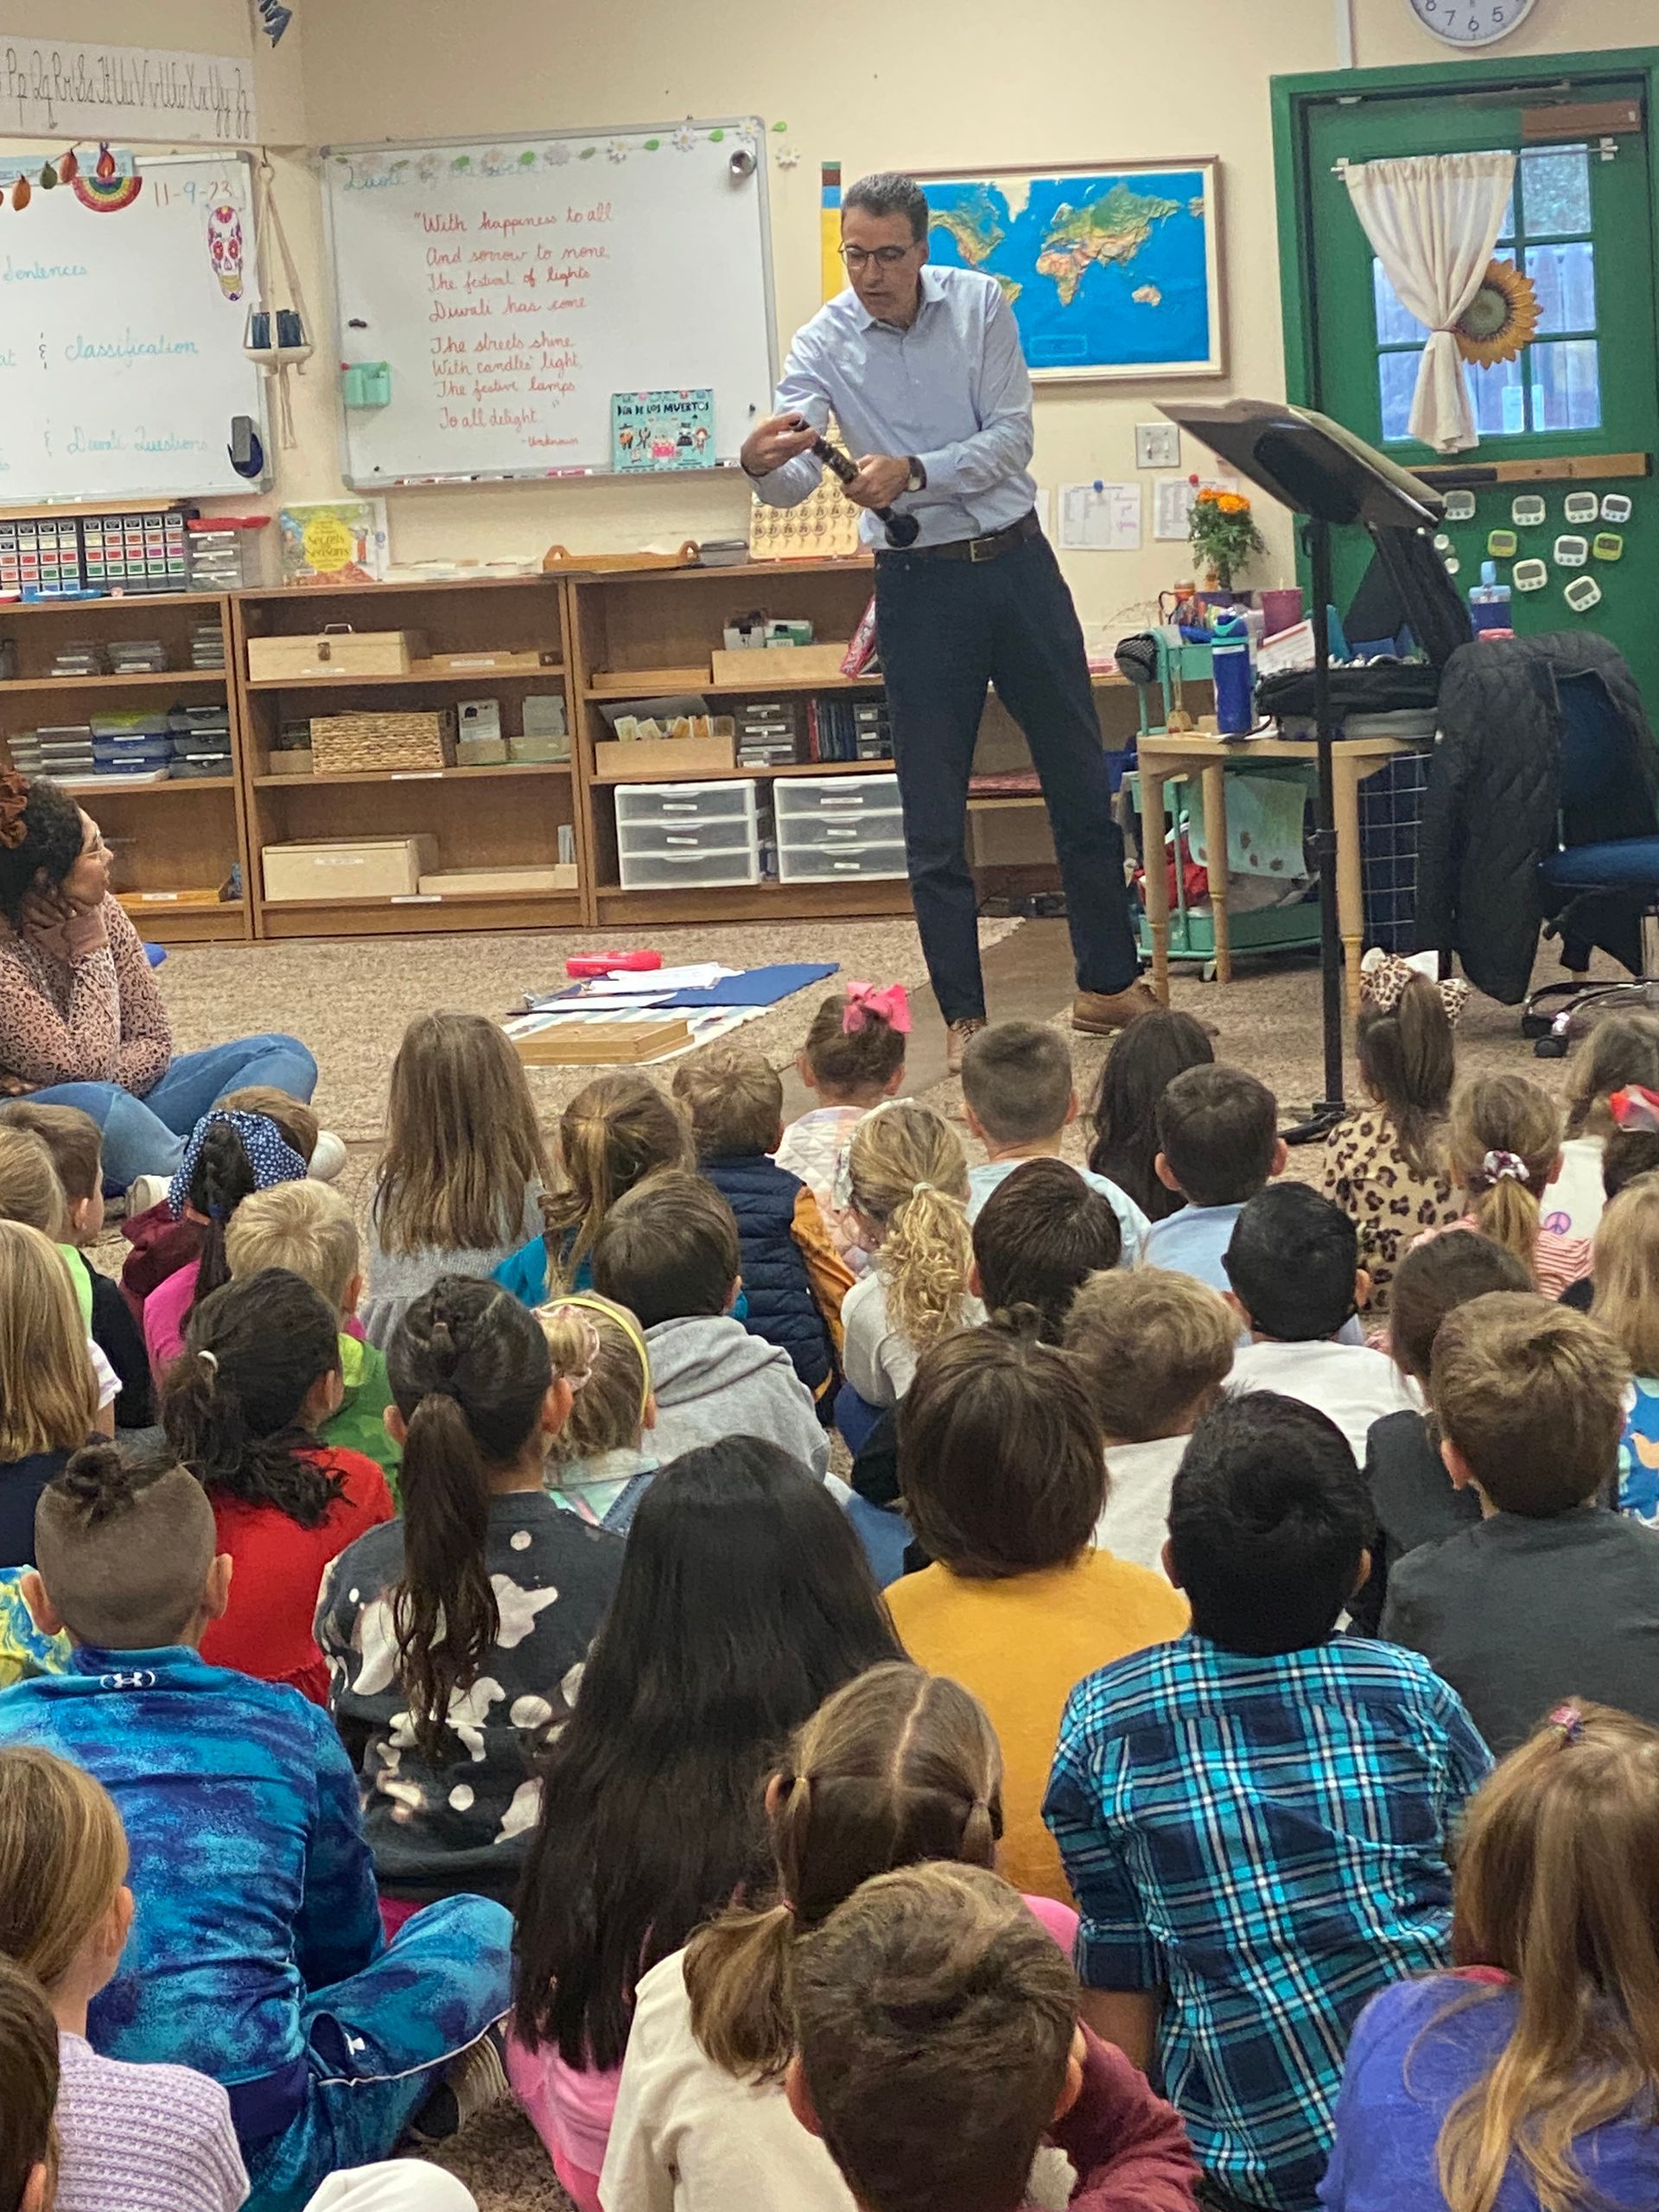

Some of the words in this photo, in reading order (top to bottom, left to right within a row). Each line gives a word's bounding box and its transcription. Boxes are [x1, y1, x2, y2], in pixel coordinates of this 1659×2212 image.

[1426, 0, 1436, 11] 8
[1445, 10, 1456, 26] 7
[1468, 16, 1479, 31] 6
[1492, 6, 1503, 22] 5
[479, 211, 557, 238] happiness
[567, 207, 582, 223] to
[587, 202, 613, 222] all
[427, 245, 461, 266] And
[470, 250, 528, 263] sorrow
[537, 243, 552, 259] to
[428, 272, 457, 292] The
[465, 270, 514, 294] festival
[523, 267, 537, 288] of
[547, 266, 590, 287] lights
[429, 298, 493, 323] Diwali
[502, 295, 542, 315] has
[548, 296, 587, 312] come
[430, 335, 467, 354] The
[474, 332, 524, 353] streets
[529, 330, 575, 349] shine
[432, 359, 472, 377] With
[436, 380, 467, 397] The
[473, 379, 518, 403] festive
[528, 376, 575, 396] lamps
[440, 407, 458, 429] To
[461, 407, 486, 427] all
[635, 405, 644, 415] DE
[646, 404, 660, 414] LOS
[664, 402, 709, 414] MUERTOS
